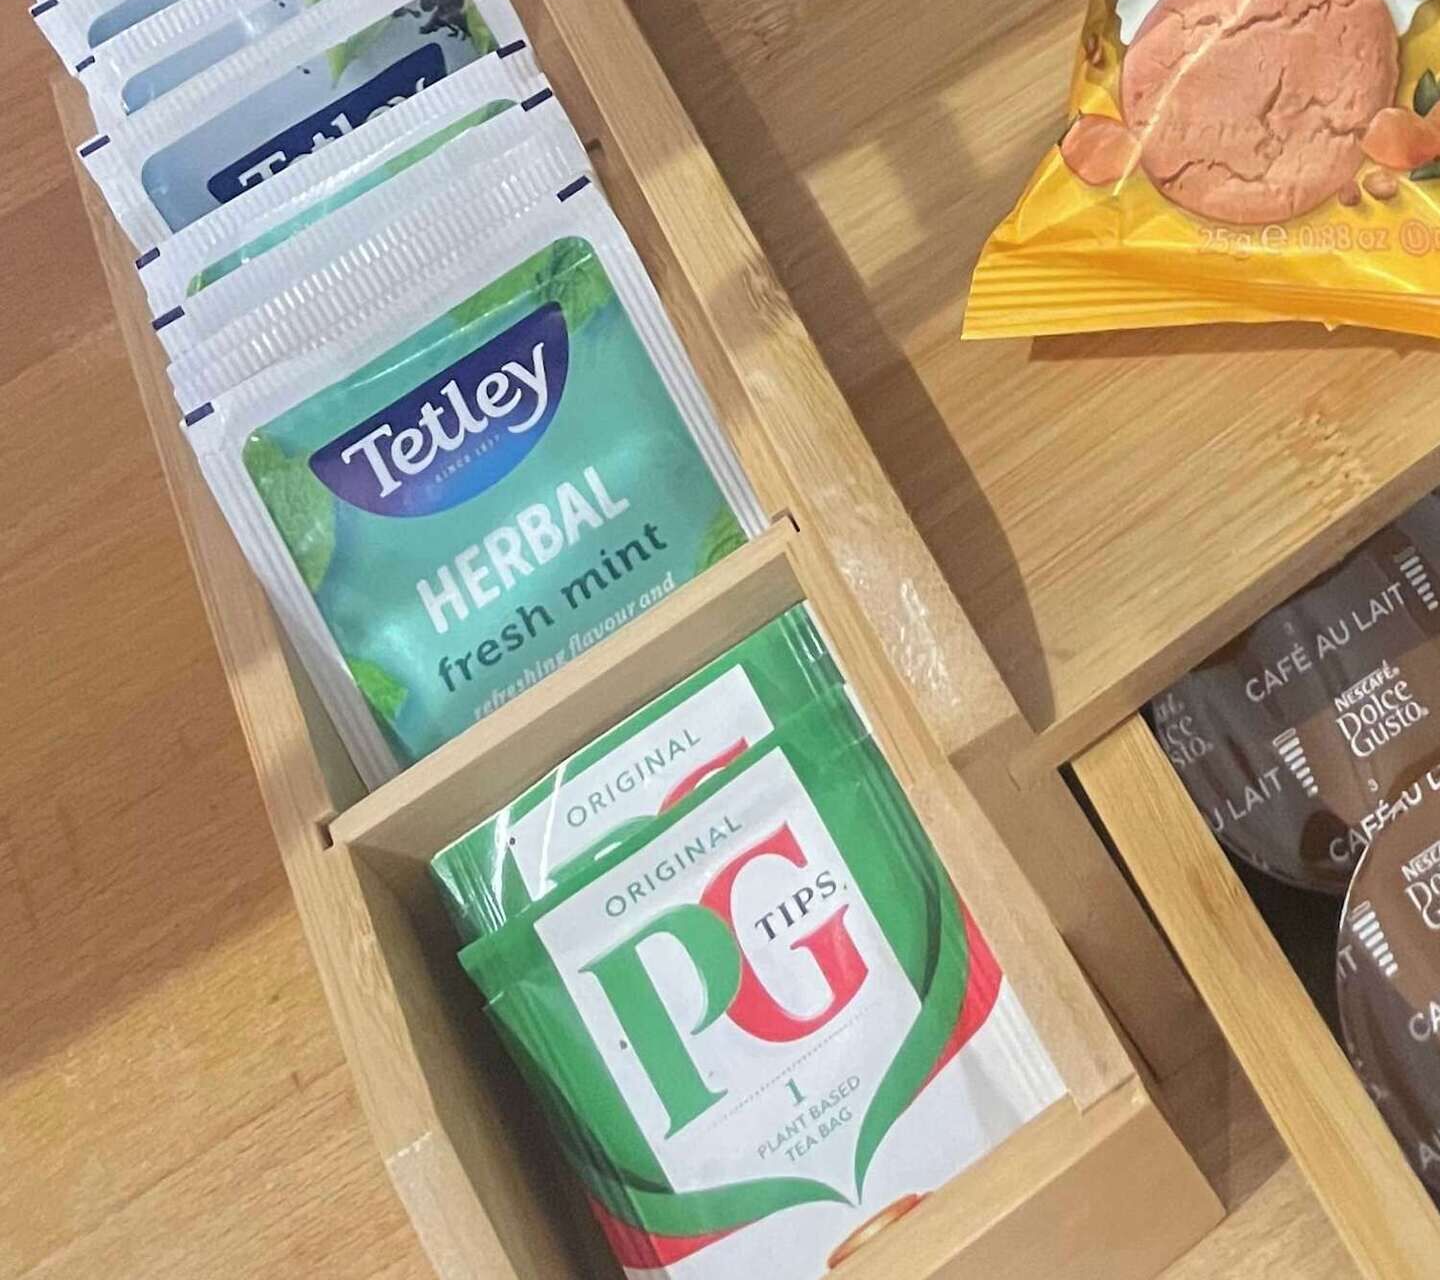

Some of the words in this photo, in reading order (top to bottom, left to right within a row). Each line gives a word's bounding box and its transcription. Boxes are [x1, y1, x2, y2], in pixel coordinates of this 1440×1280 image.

[341, 342, 548, 498] Tetley
[416, 465, 630, 634] HERBAL
[438, 603, 555, 692] fresh
[561, 523, 667, 608] mint
[568, 602, 636, 660] flavour
[639, 571, 675, 609] and
[1246, 643, 1312, 701] CAFÉ
[1316, 619, 1350, 659] AU
[1352, 582, 1404, 632] LAIT
[1334, 659, 1393, 712] NESCAFÉ
[1336, 680, 1413, 740] Dolce
[1351, 702, 1421, 757] Gusto
[567, 729, 702, 828] ORIGINAL
[1227, 766, 1282, 820] LAIT
[605, 816, 743, 918] ORIGINAL
[755, 870, 838, 943] TIPS
[577, 821, 869, 1140] PG
[757, 1113, 809, 1160] PLANT
[808, 1075, 861, 1121] BASED
[785, 1077, 807, 1107] 1
[785, 1134, 819, 1163] TEA
[818, 1106, 853, 1139] BAG
